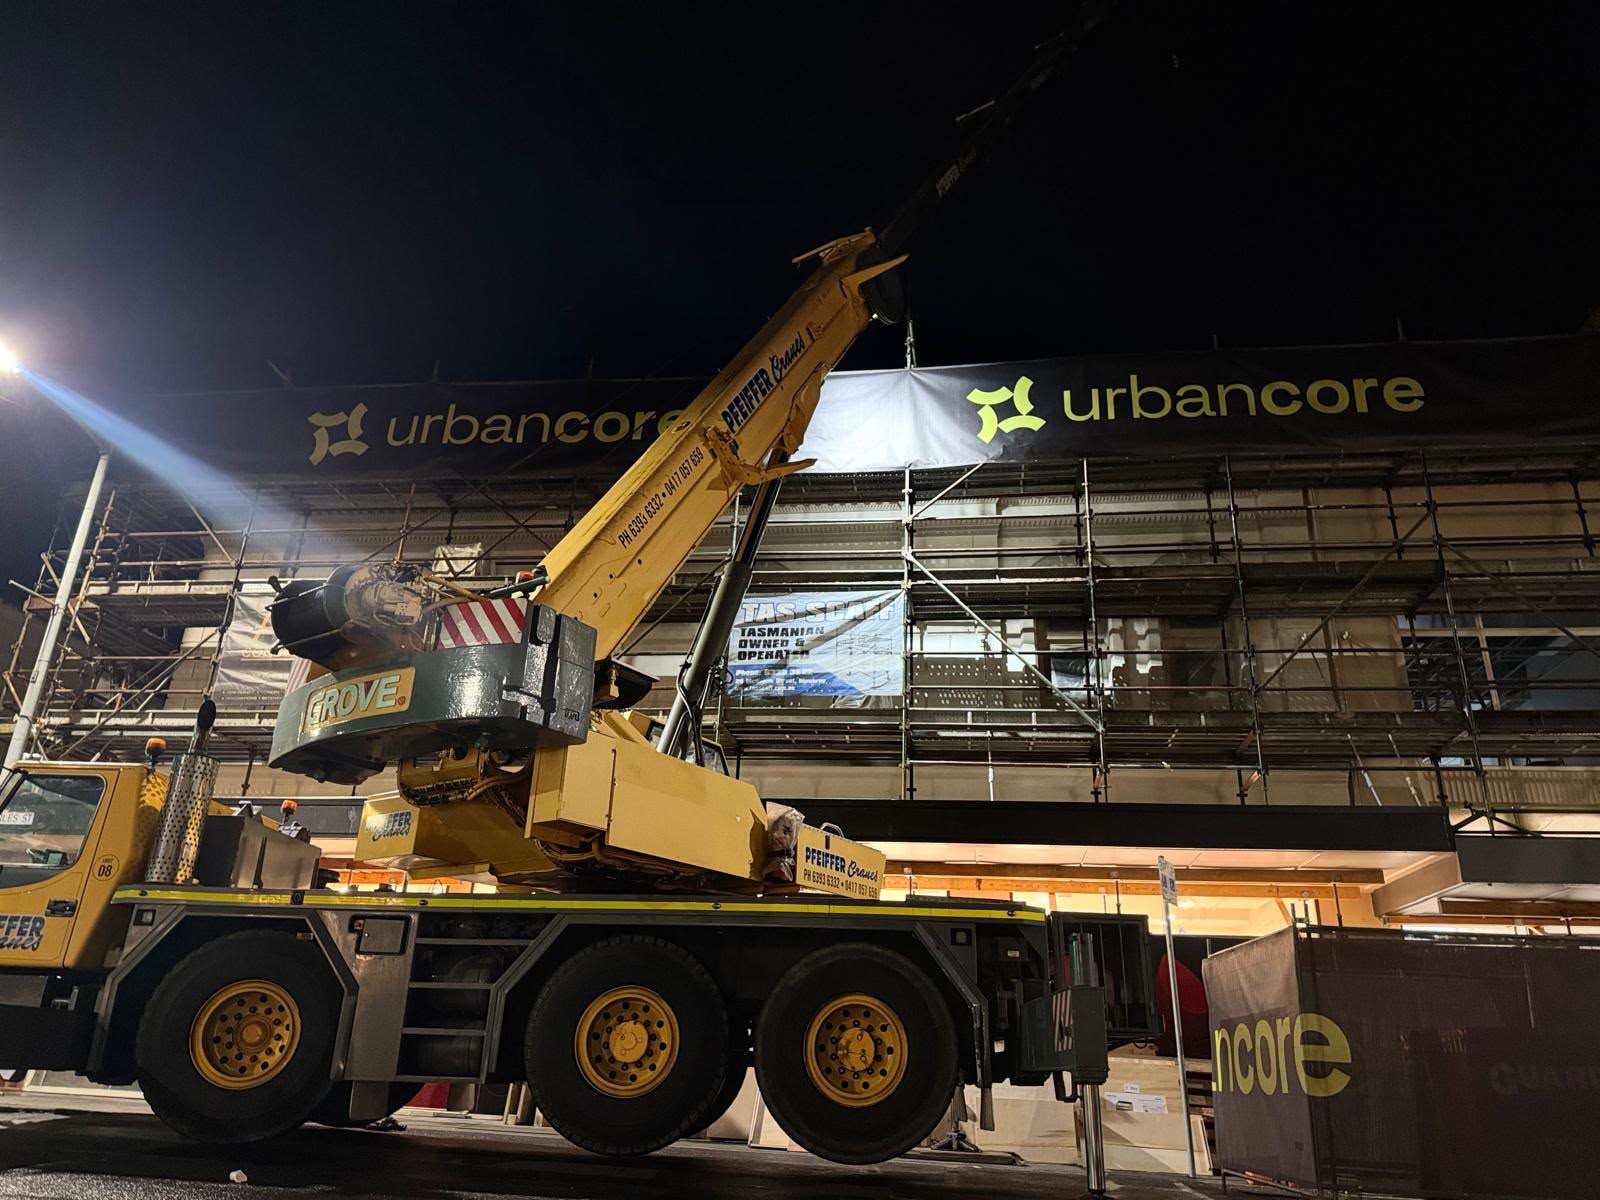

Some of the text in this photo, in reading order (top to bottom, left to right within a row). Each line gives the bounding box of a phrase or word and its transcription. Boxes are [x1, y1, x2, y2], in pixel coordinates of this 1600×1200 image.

[720, 331, 806, 434] PFEIFFER Cranes
[1062, 374, 1426, 422] urbancore
[617, 529, 633, 548] PH
[644, 494, 664, 525] 6332
[664, 472, 682, 497] 0417
[679, 460, 695, 481] 057
[691, 446, 704, 467] 659
[741, 600, 896, 623] TAS SCAFF
[738, 639, 789, 649] OWNED
[740, 626, 825, 637] TASMANIAN
[306, 674, 402, 725] GROVE
[98, 864, 112, 877] 08
[803, 868, 811, 881] PH
[812, 870, 826, 886] 6393
[826, 874, 840, 889] 6332
[844, 879, 858, 893] 0417
[805, 846, 879, 882] PFEIFFER Cranes
[1211, 1012, 1352, 1097] ncore
